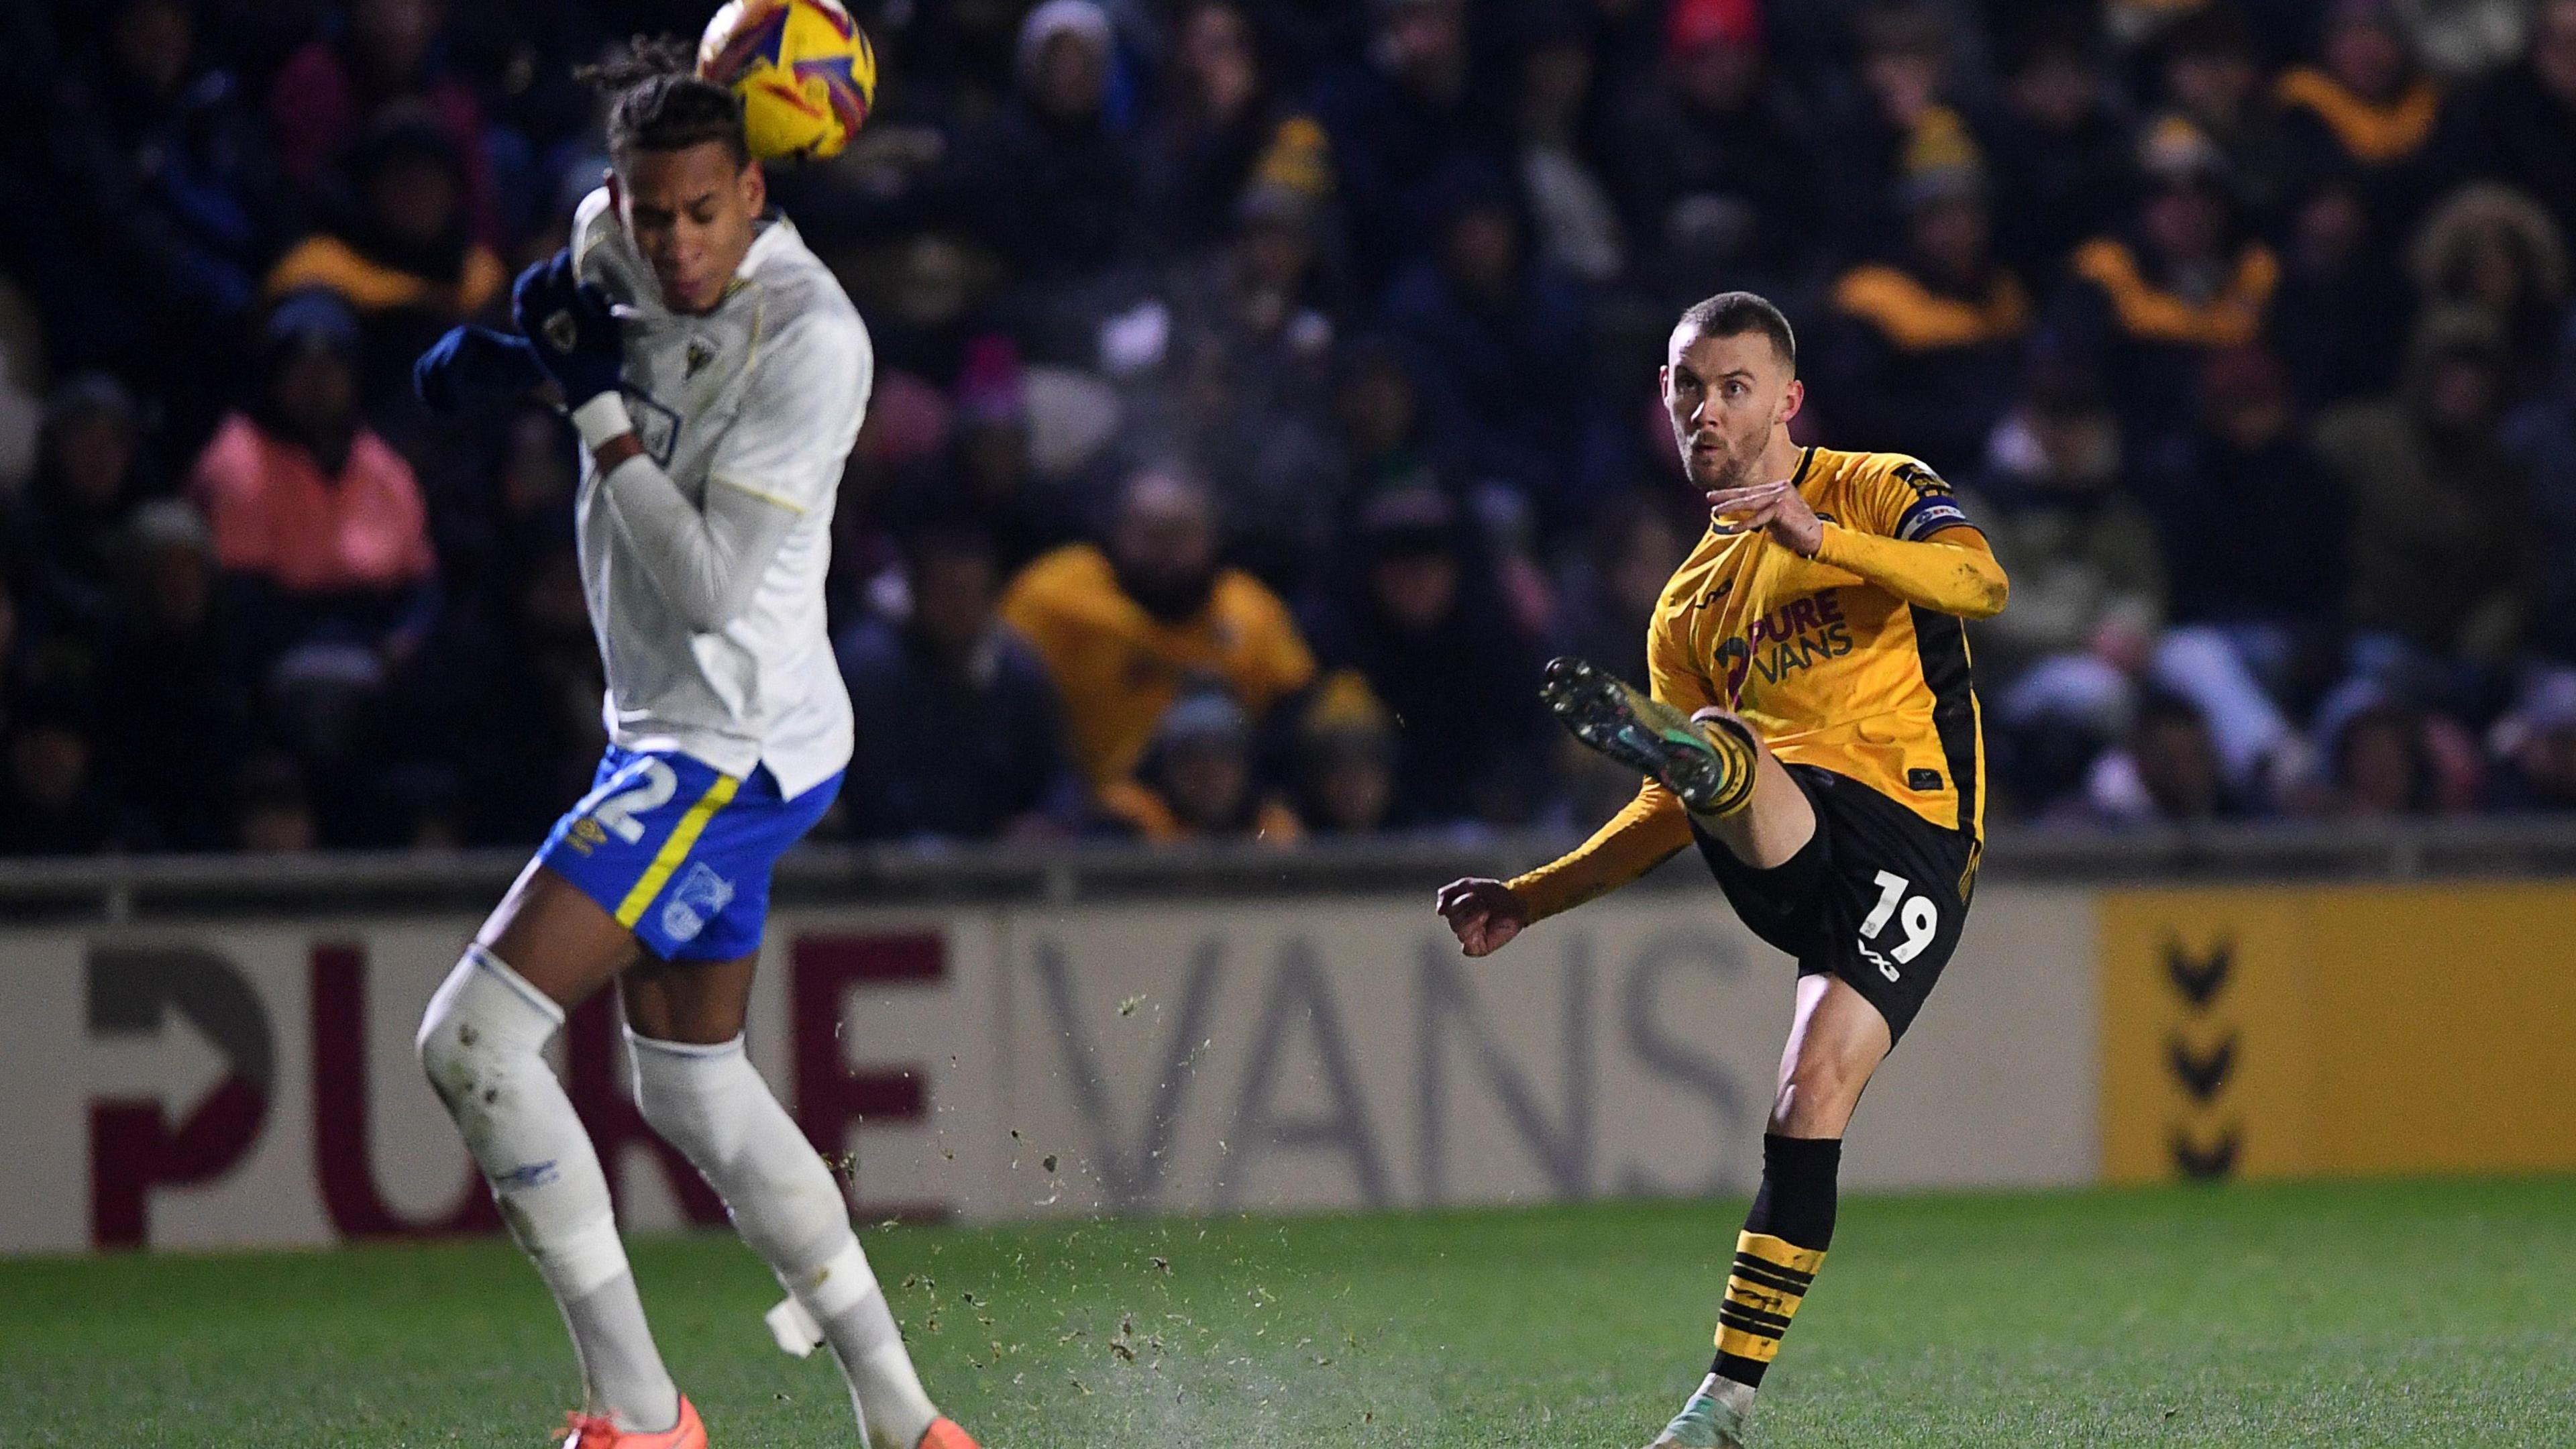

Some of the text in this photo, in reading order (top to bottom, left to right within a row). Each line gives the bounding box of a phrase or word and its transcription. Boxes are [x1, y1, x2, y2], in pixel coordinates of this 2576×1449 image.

[1747, 588, 1845, 656] PURE
[1752, 620, 1854, 686] VANS
[1859, 869, 1938, 964] 19
[1032, 926, 1752, 1208] VANS
